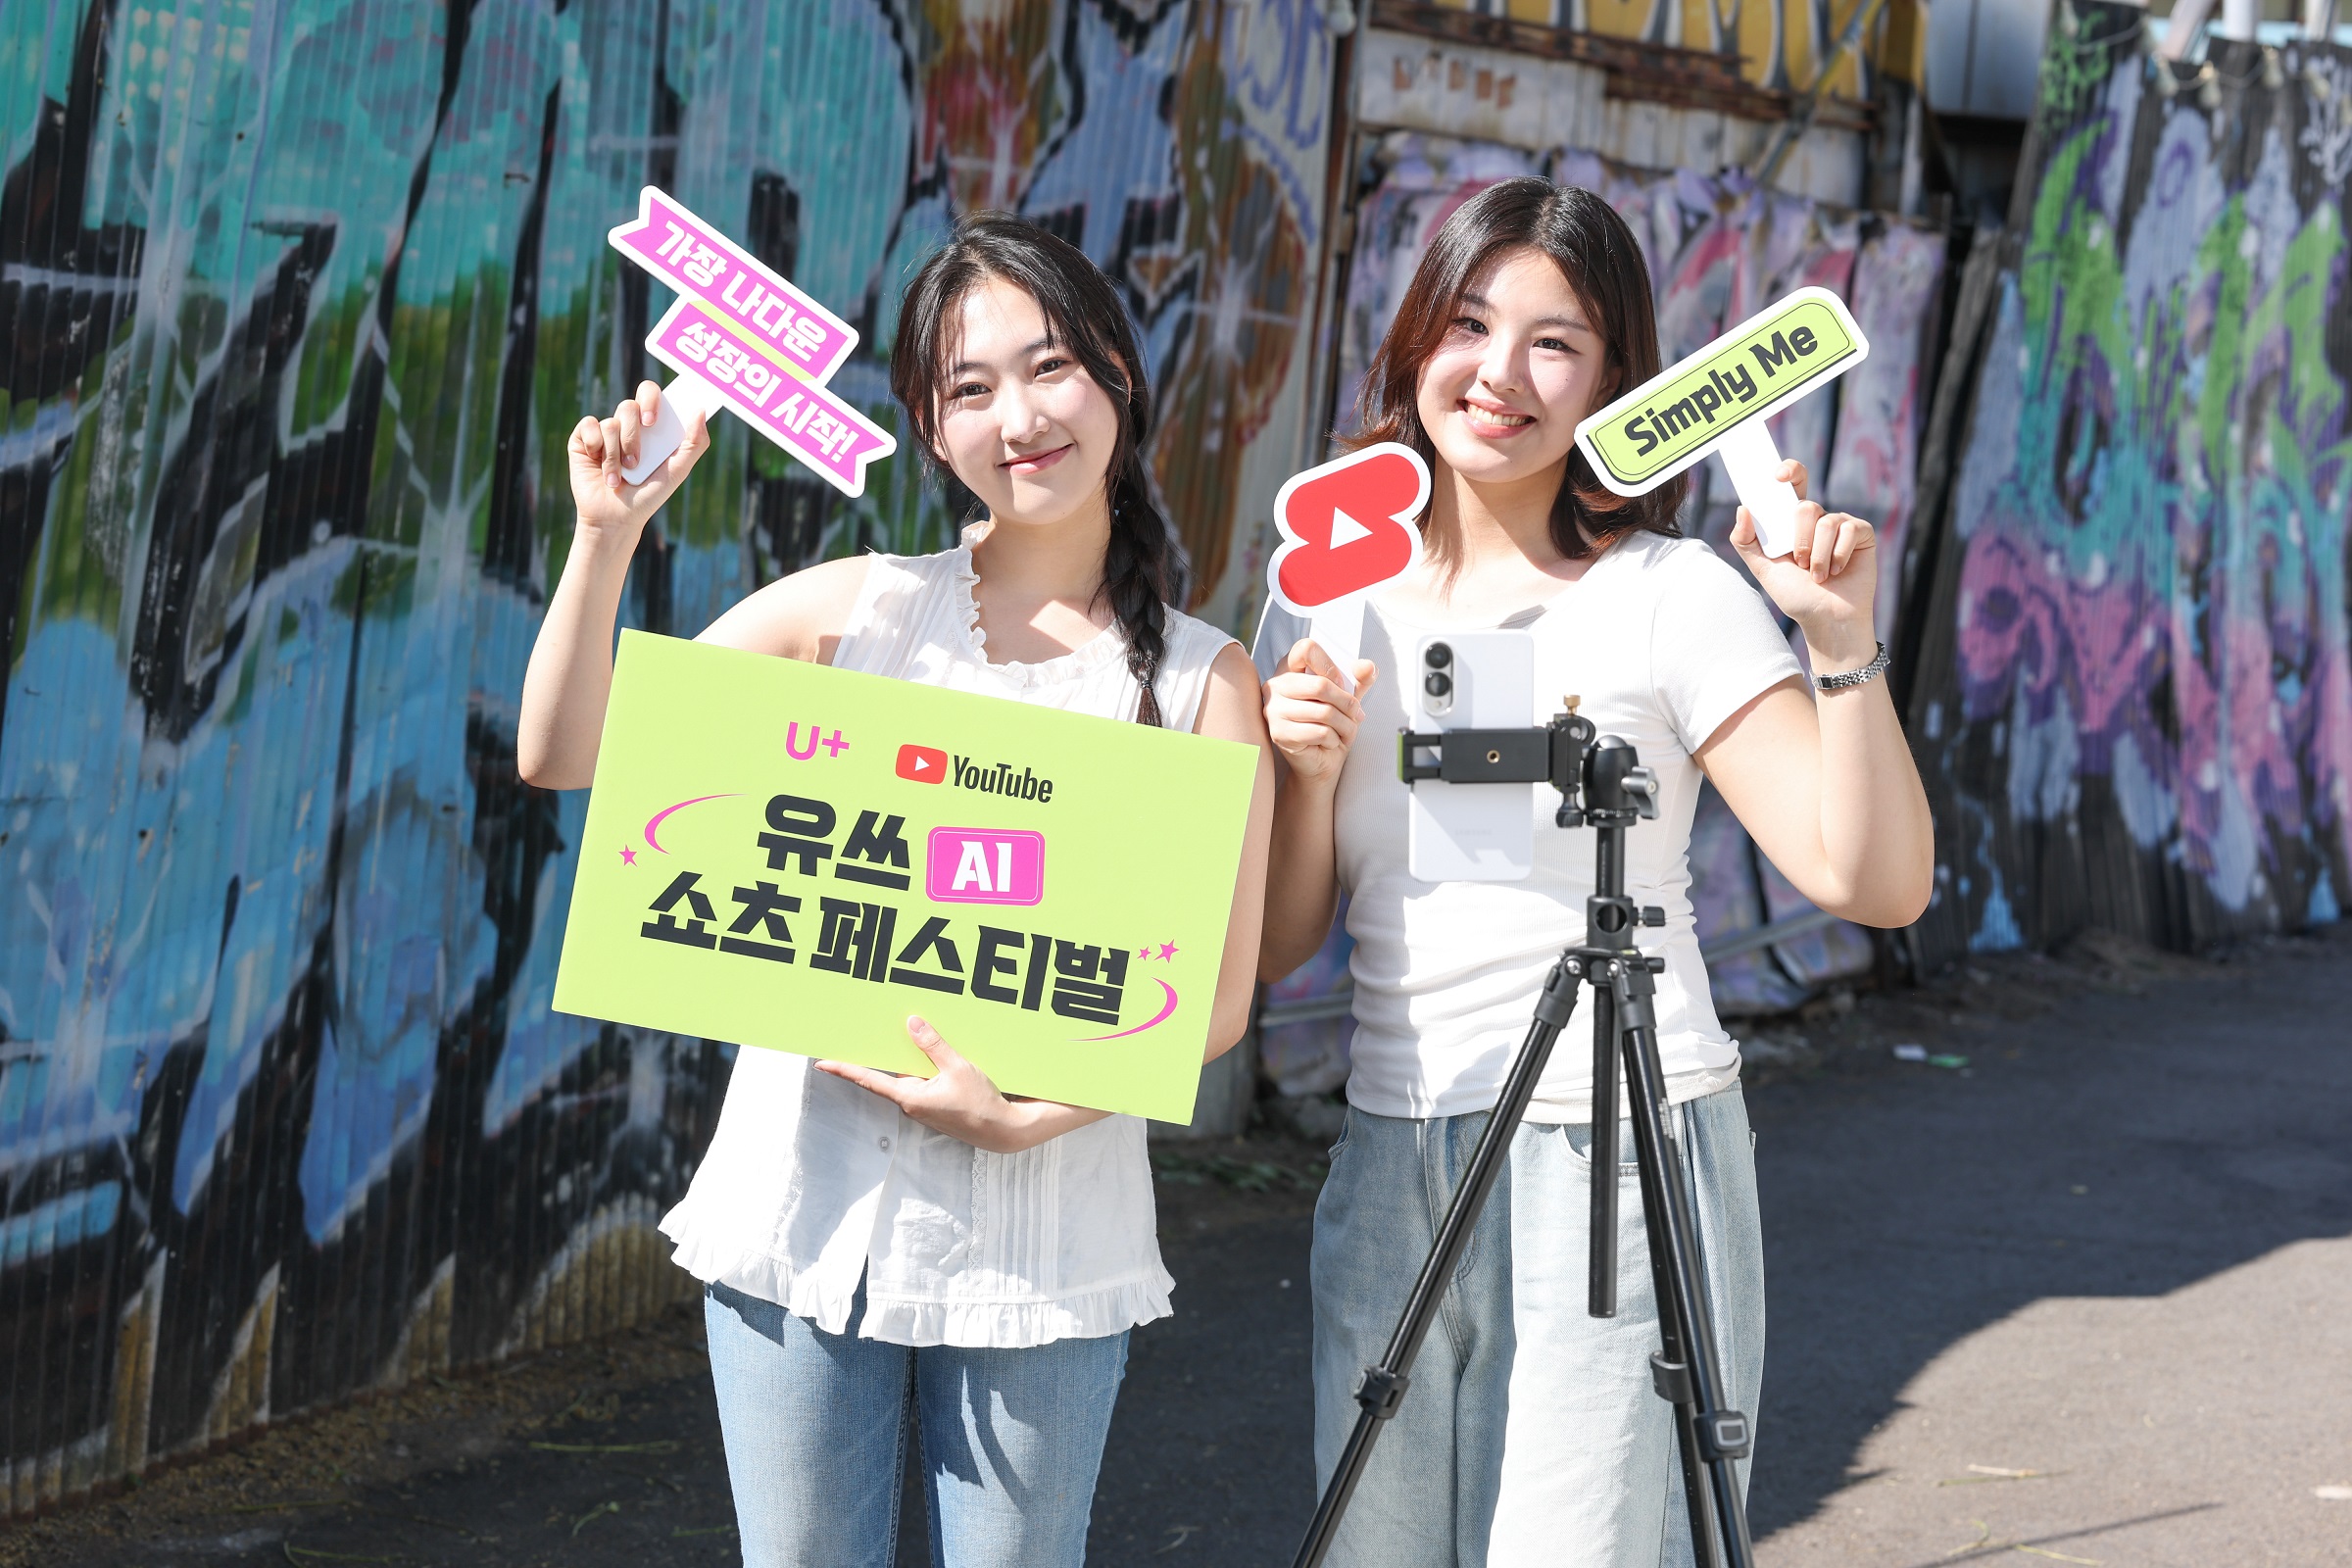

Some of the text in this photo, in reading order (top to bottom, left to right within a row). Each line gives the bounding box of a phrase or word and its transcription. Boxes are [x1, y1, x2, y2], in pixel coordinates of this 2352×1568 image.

[655, 220, 827, 363] 가장 나다운
[675, 321, 859, 464] 성장의 시작!
[1624, 325, 1818, 458] Simply Me
[785, 721, 851, 761] U+
[954, 755, 1054, 804] YouTube
[757, 794, 1013, 893] 유쓰 AI
[640, 870, 1131, 1026] 쇼츠 페스티벌
